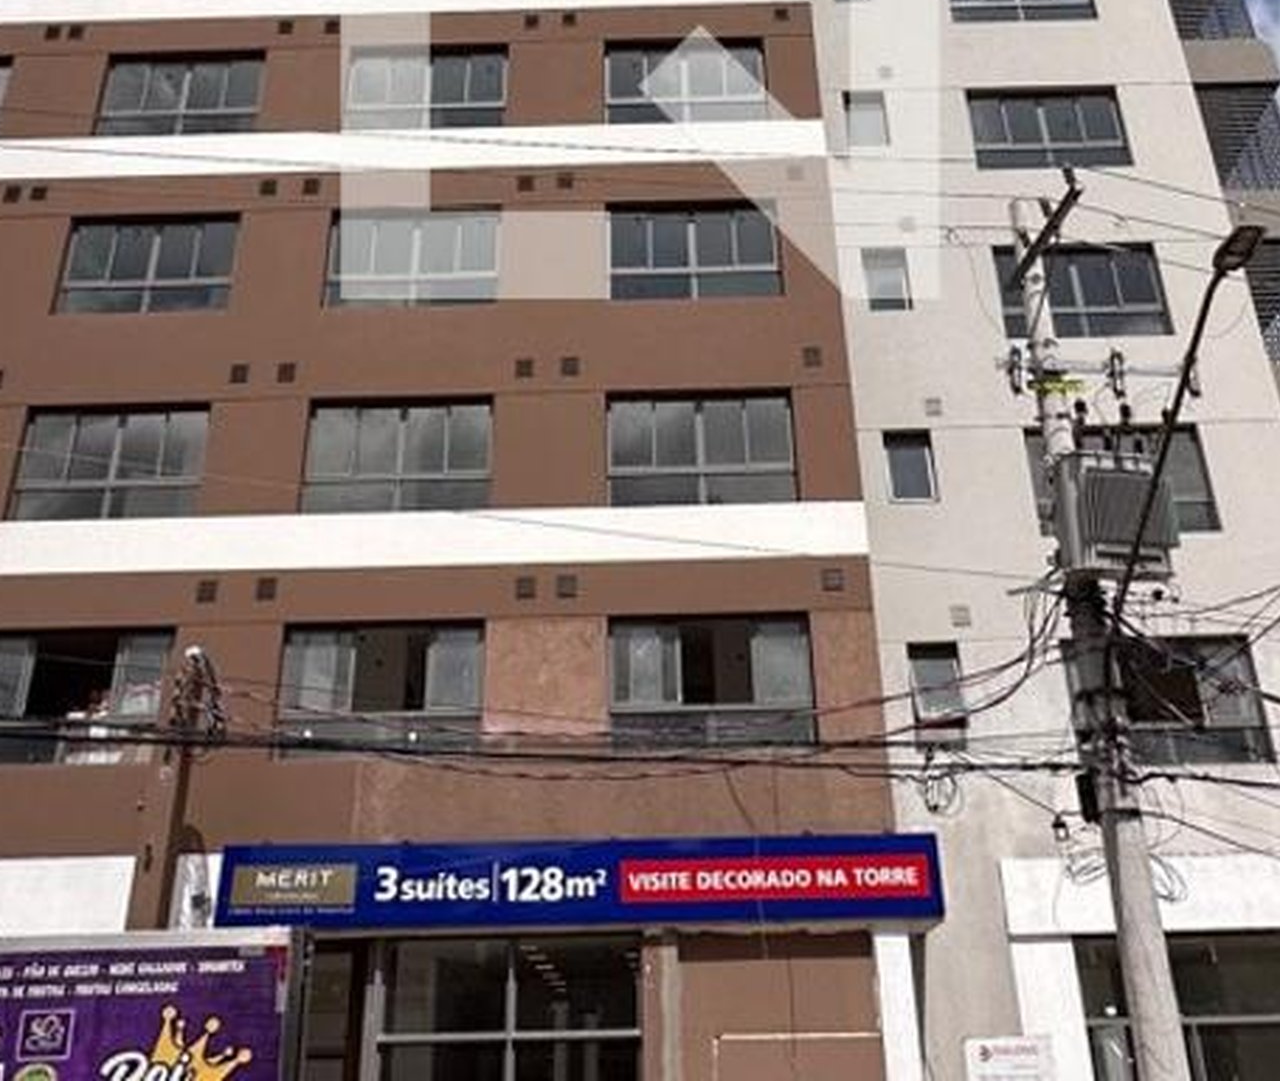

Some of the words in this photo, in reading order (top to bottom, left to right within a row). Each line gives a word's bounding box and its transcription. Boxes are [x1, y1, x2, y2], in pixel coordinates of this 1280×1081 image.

[255, 869, 334, 888] MERIT
[628, 871, 691, 892] VISITE
[696, 868, 811, 891] DECORADO
[817, 868, 847, 887] NA
[853, 866, 919, 886] TORRE
